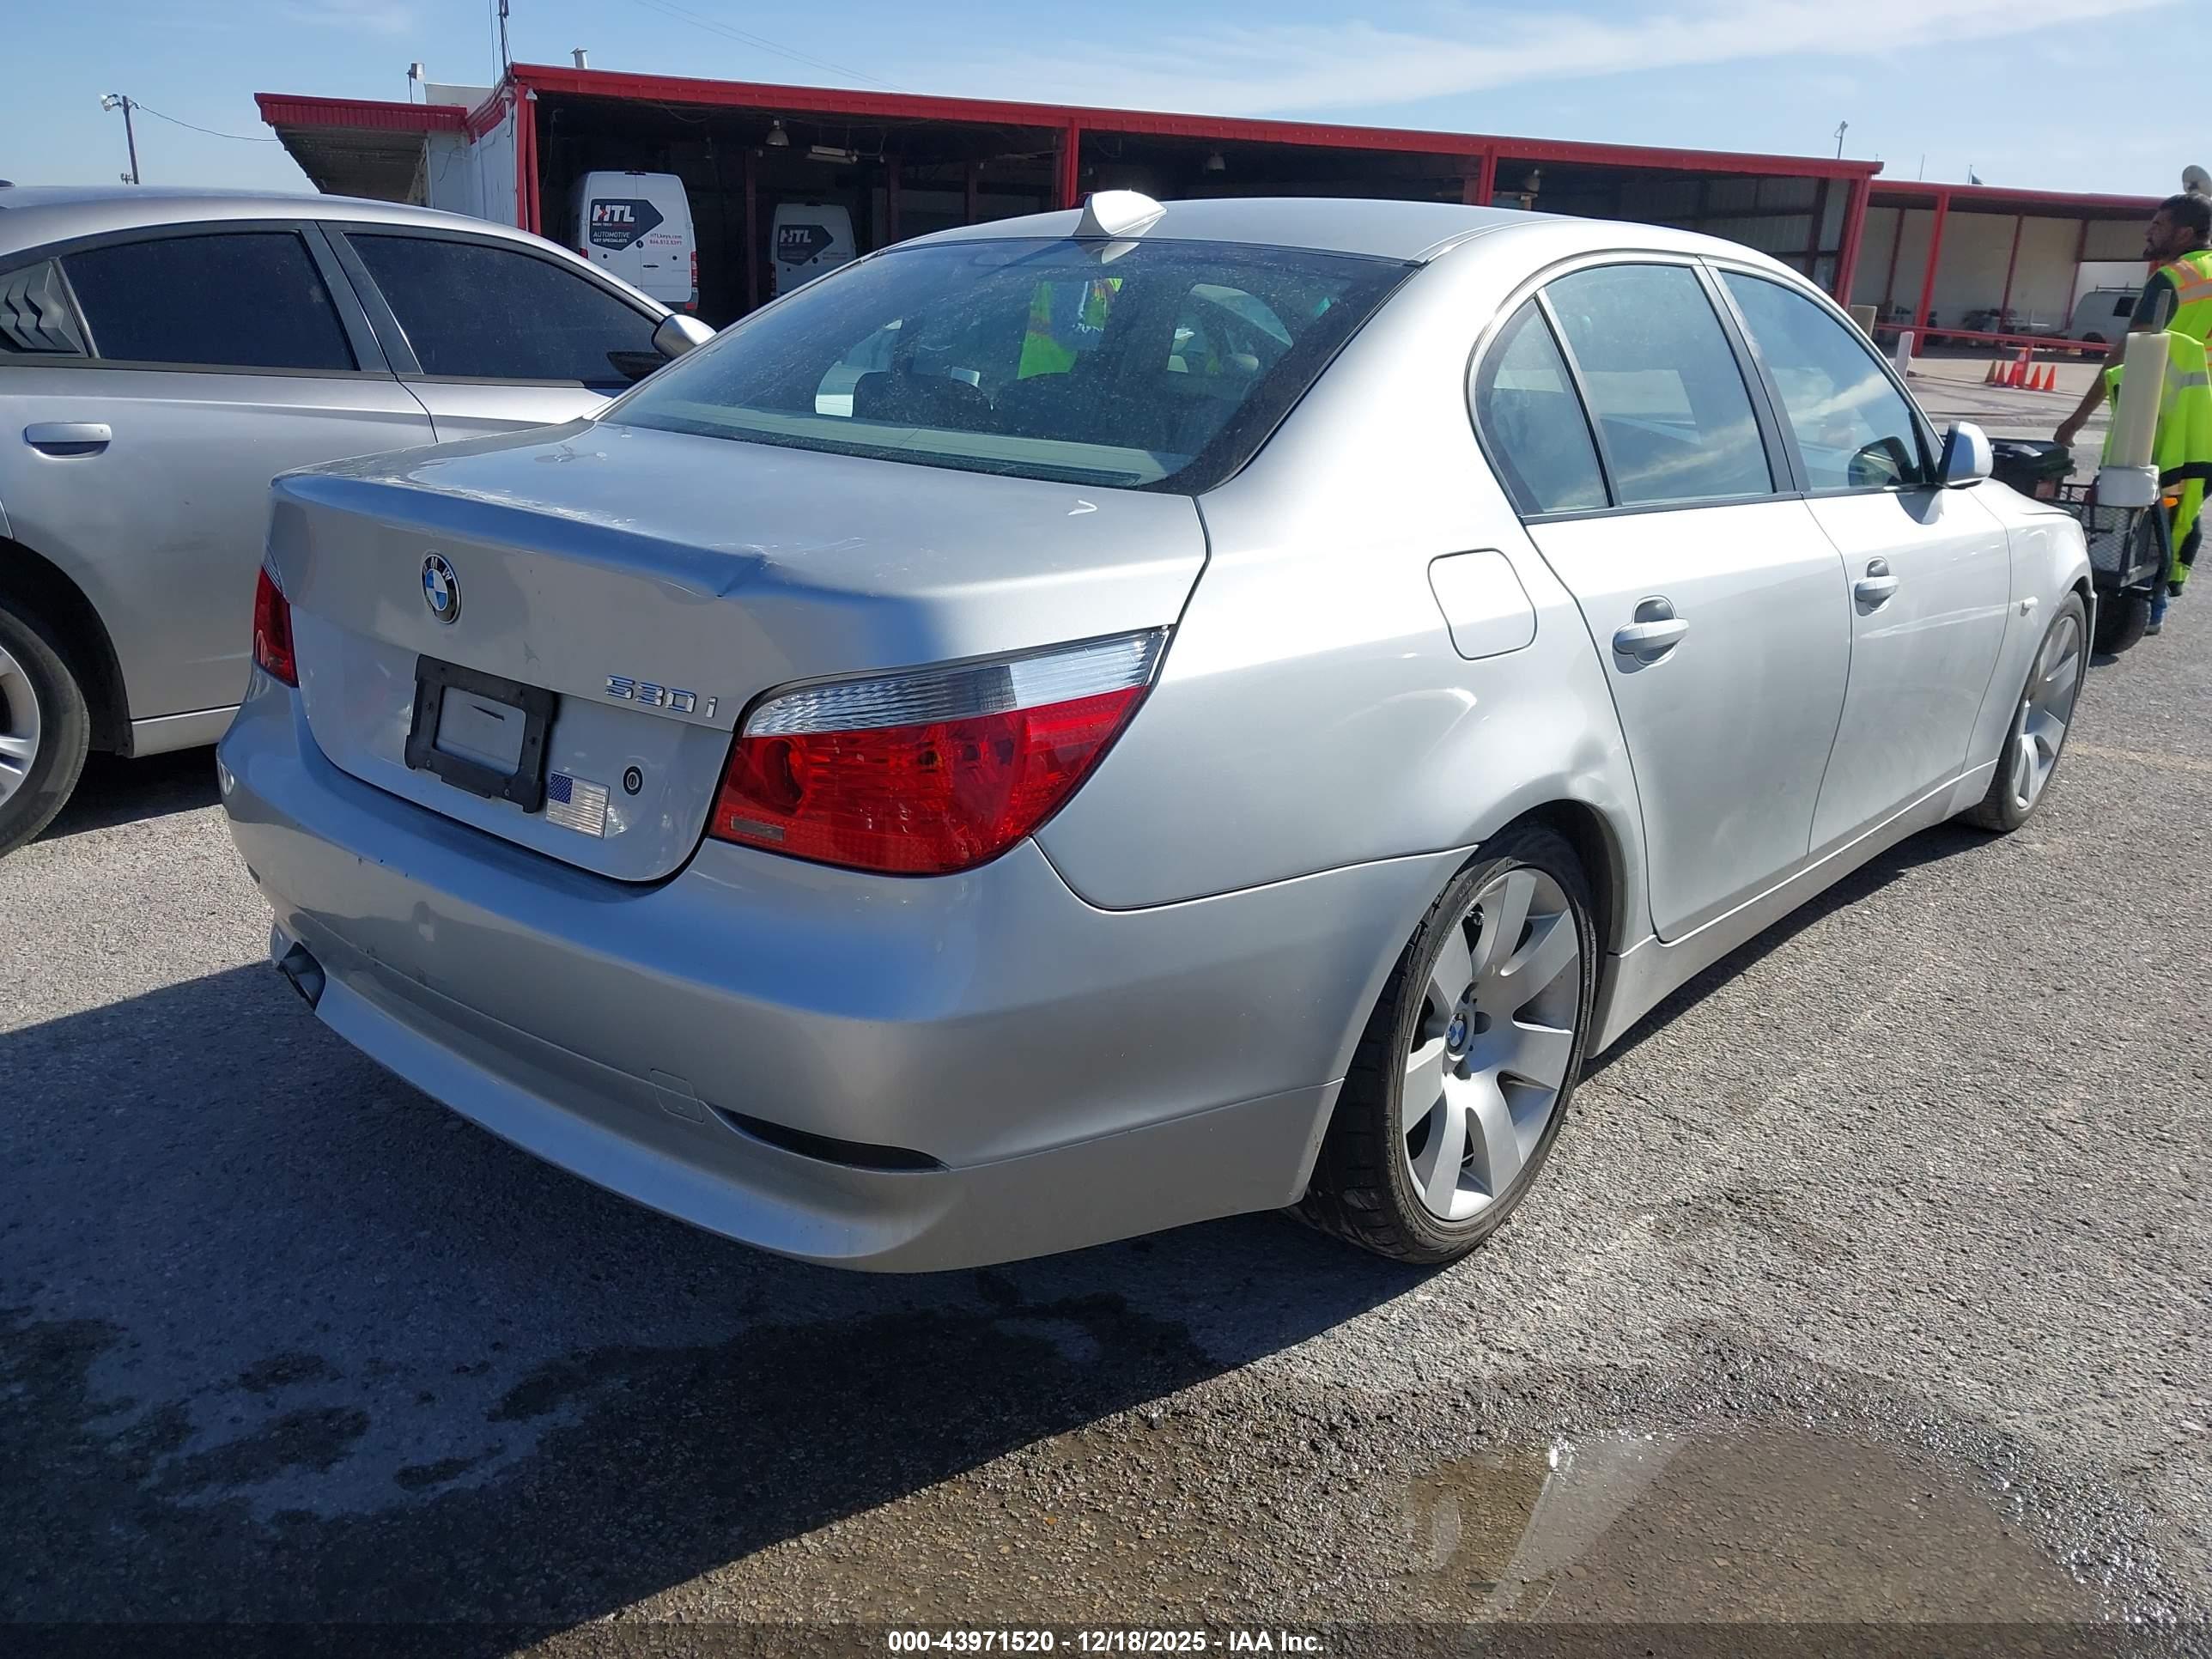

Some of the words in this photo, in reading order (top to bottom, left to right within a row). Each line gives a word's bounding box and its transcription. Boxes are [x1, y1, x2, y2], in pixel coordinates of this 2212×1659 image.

[592, 204, 635, 222] HTL
[780, 229, 811, 243] HTL
[422, 556, 453, 581] BMW
